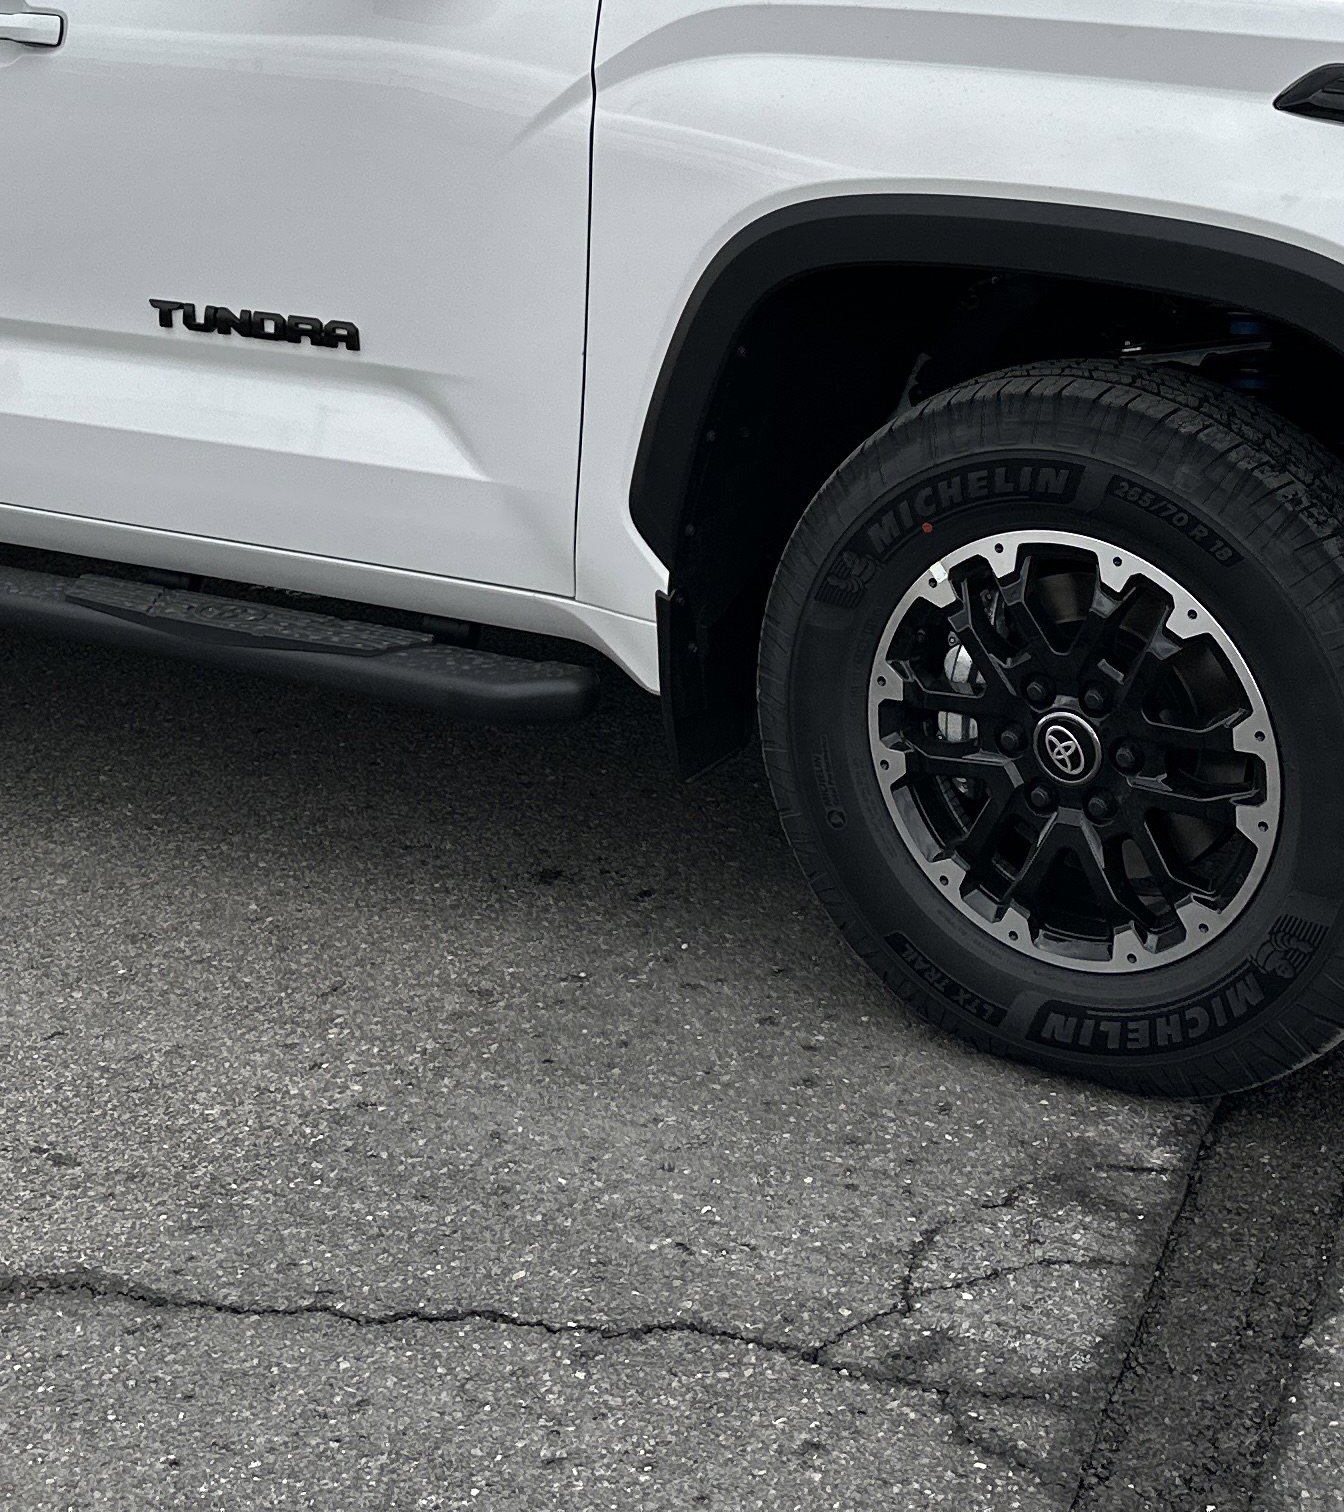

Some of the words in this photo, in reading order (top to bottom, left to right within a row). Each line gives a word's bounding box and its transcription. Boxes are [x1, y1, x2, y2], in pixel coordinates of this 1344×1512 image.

[148, 298, 361, 352] TUNDRA
[867, 466, 1071, 553] MICHELIN
[1188, 524, 1209, 543] R
[1209, 539, 1233, 562] 18
[902, 942, 954, 993] TRAIL
[950, 987, 995, 1021] LTX
[1040, 971, 1266, 1050] MICHELIN
